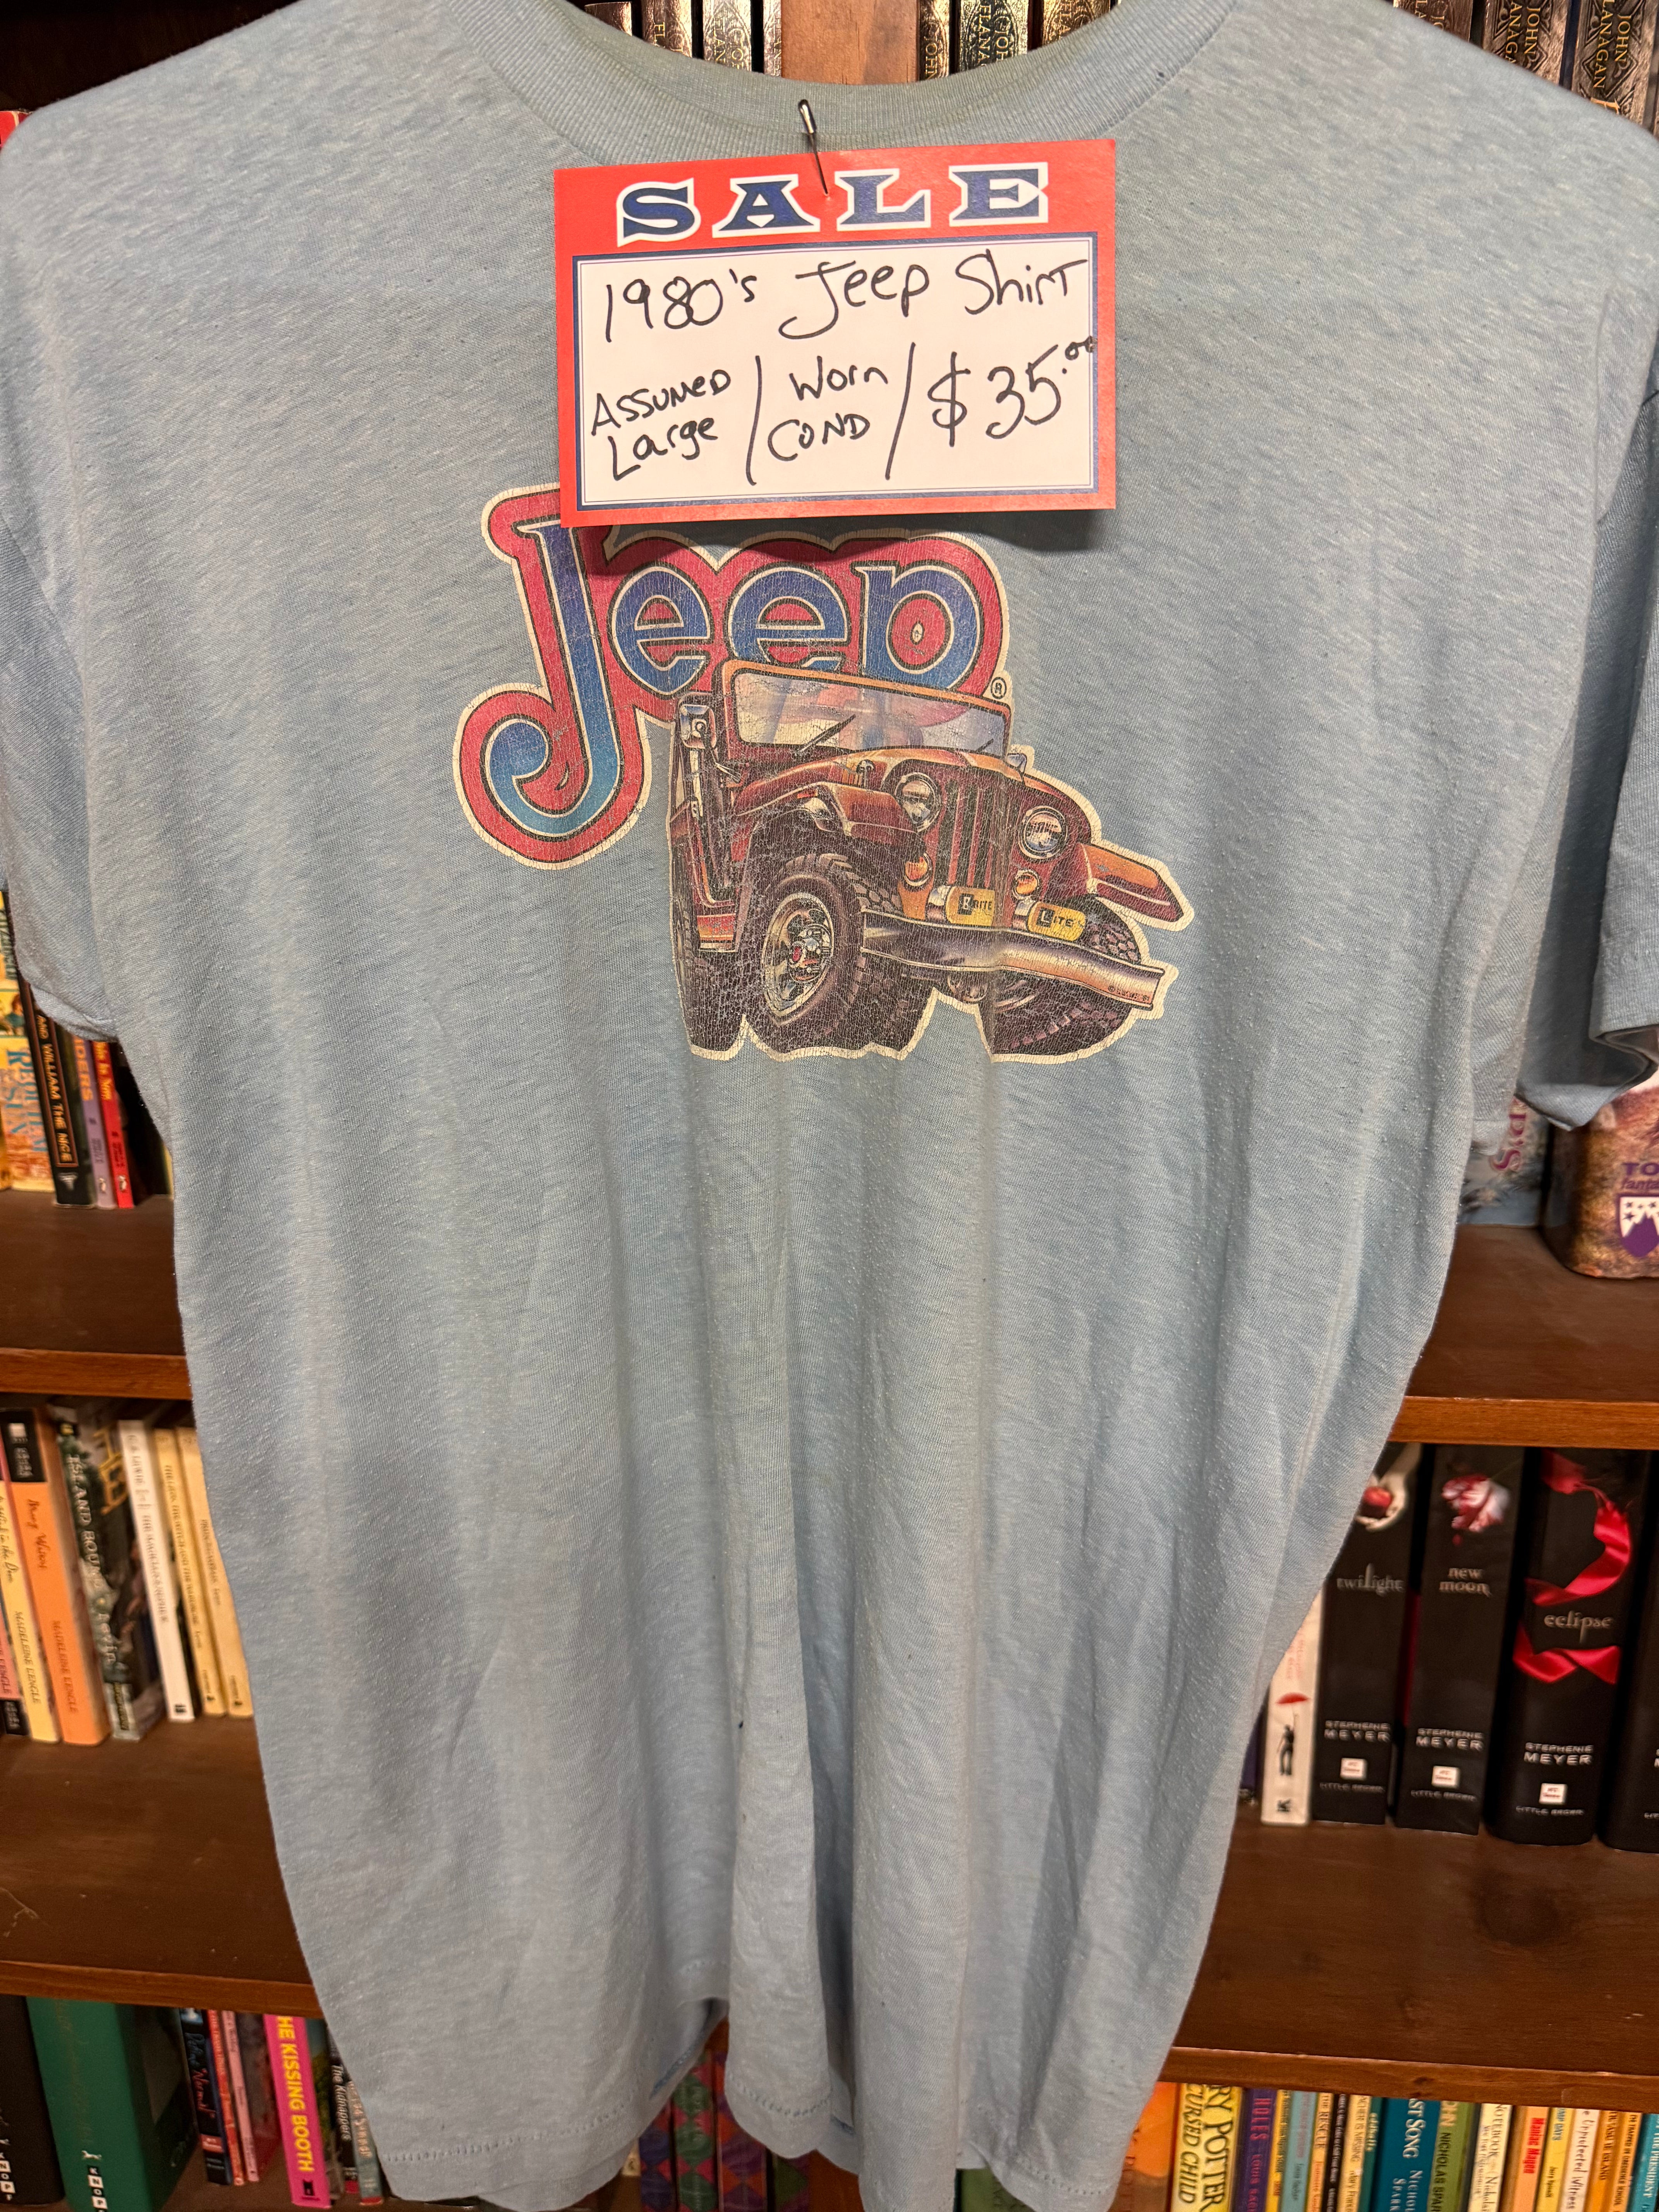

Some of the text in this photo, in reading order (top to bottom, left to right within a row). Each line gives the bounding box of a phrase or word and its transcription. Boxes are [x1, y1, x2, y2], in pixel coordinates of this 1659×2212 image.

[1524, 7, 1544, 55] JOHN
[1614, 14, 1631, 62] JOHN
[617, 162, 1048, 247] SALE
[605, 269, 757, 343] 1980's
[778, 261, 930, 340] Jeep
[789, 356, 888, 400] Worn
[607, 413, 871, 481] Large COND
[461, 494, 999, 860] Jeep
[1037, 909, 1073, 928] LITE
[42, 1043, 62, 1100] WILLIAM
[52, 1103, 67, 1130] THE
[66, 1455, 92, 1526] ISLAND
[1336, 1563, 1405, 1597] twilight
[1439, 1581, 1492, 1598] moon
[1448, 1567, 1484, 1580] new
[1544, 1611, 1614, 1643] eclipse
[1324, 1729, 1391, 1743] MEYER
[1415, 1736, 1484, 1752] MEYER
[1523, 1752, 1593, 1766] MEYER
[280, 2042, 306, 2111] KISSING
[331, 2065, 352, 2142] The Kidnappers
[1250, 2098, 1272, 2141] HOLES
[291, 2115, 315, 2172] BOOTH
[1179, 2084, 1204, 2203] CURSED CHILD
[1316, 2111, 1329, 2150] RESCUE
[1402, 2119, 1426, 2159] SONG
[1527, 2118, 1546, 2146] Maniac
[1551, 2123, 1564, 2142] DAYS
[1572, 2119, 1595, 2174] Unprotected
[1199, 2120, 1234, 2212] POTTER
[1250, 2154, 1262, 2185] LOUIS
[1434, 2132, 1451, 2184] NICHOLAS
[1643, 2150, 1659, 2198] PRESIDENT
[1566, 2176, 1585, 2210] Witness
